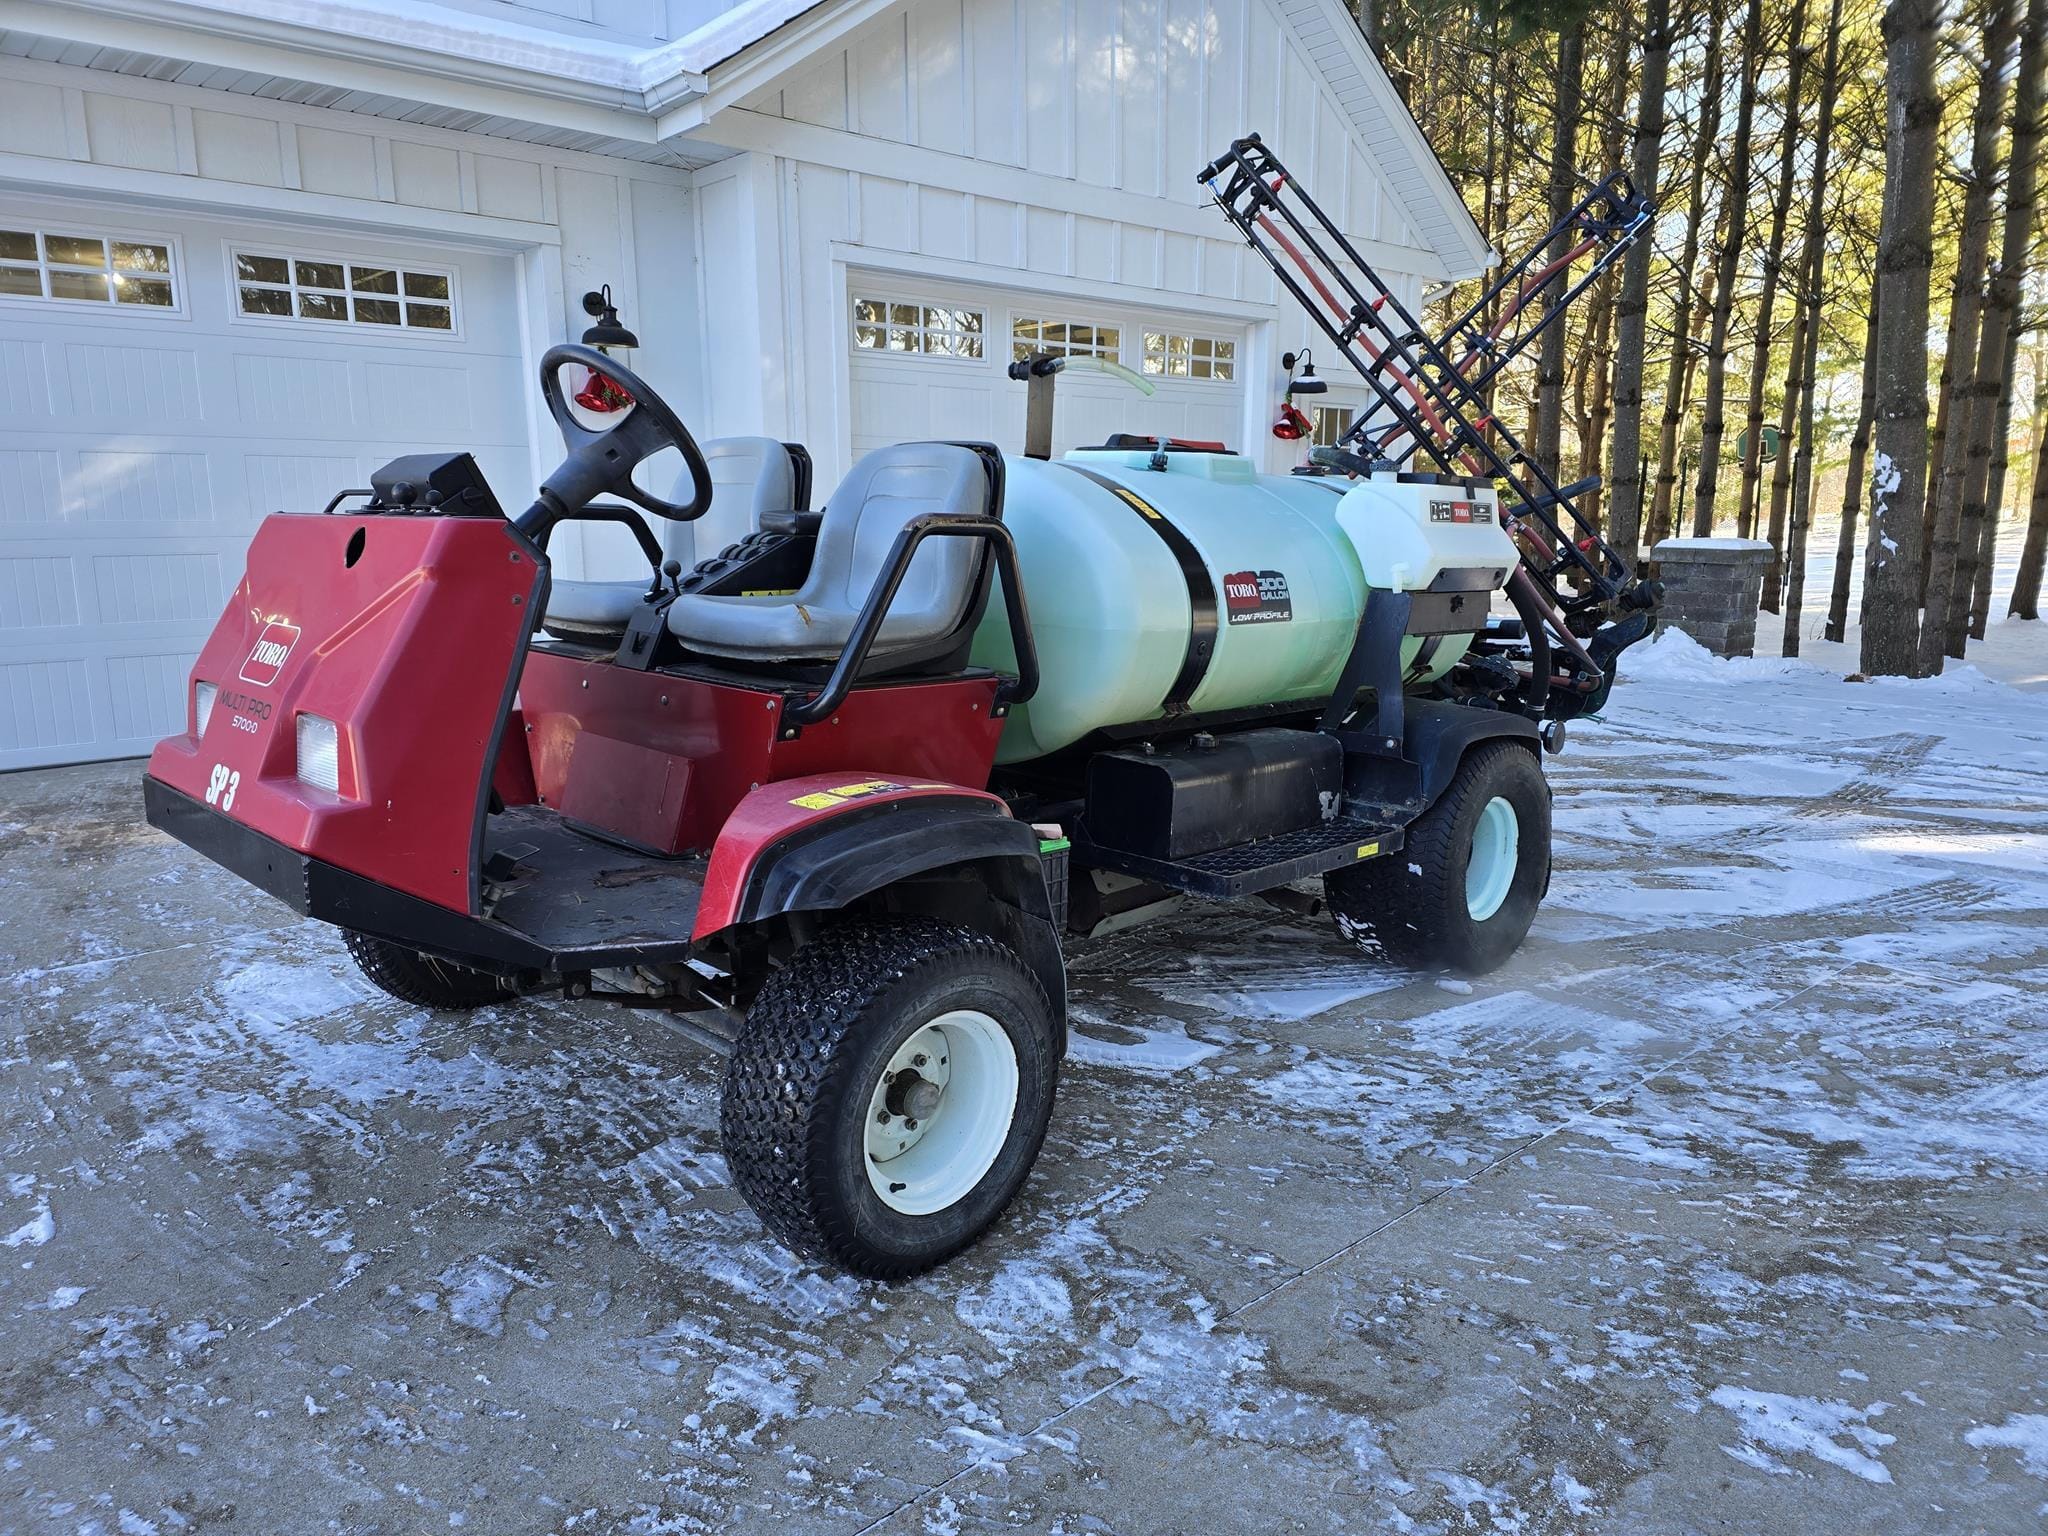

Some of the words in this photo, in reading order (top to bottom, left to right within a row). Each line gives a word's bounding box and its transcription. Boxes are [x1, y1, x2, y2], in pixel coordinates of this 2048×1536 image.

[1454, 509, 1469, 517] TORO
[1256, 578, 1286, 590] 300
[1227, 584, 1257, 598] TORO
[1260, 590, 1289, 600] GALLON
[1254, 611, 1289, 620] PROFILE
[251, 640, 288, 667] TORO
[219, 690, 247, 713] MULTI
[247, 698, 272, 721] PRO
